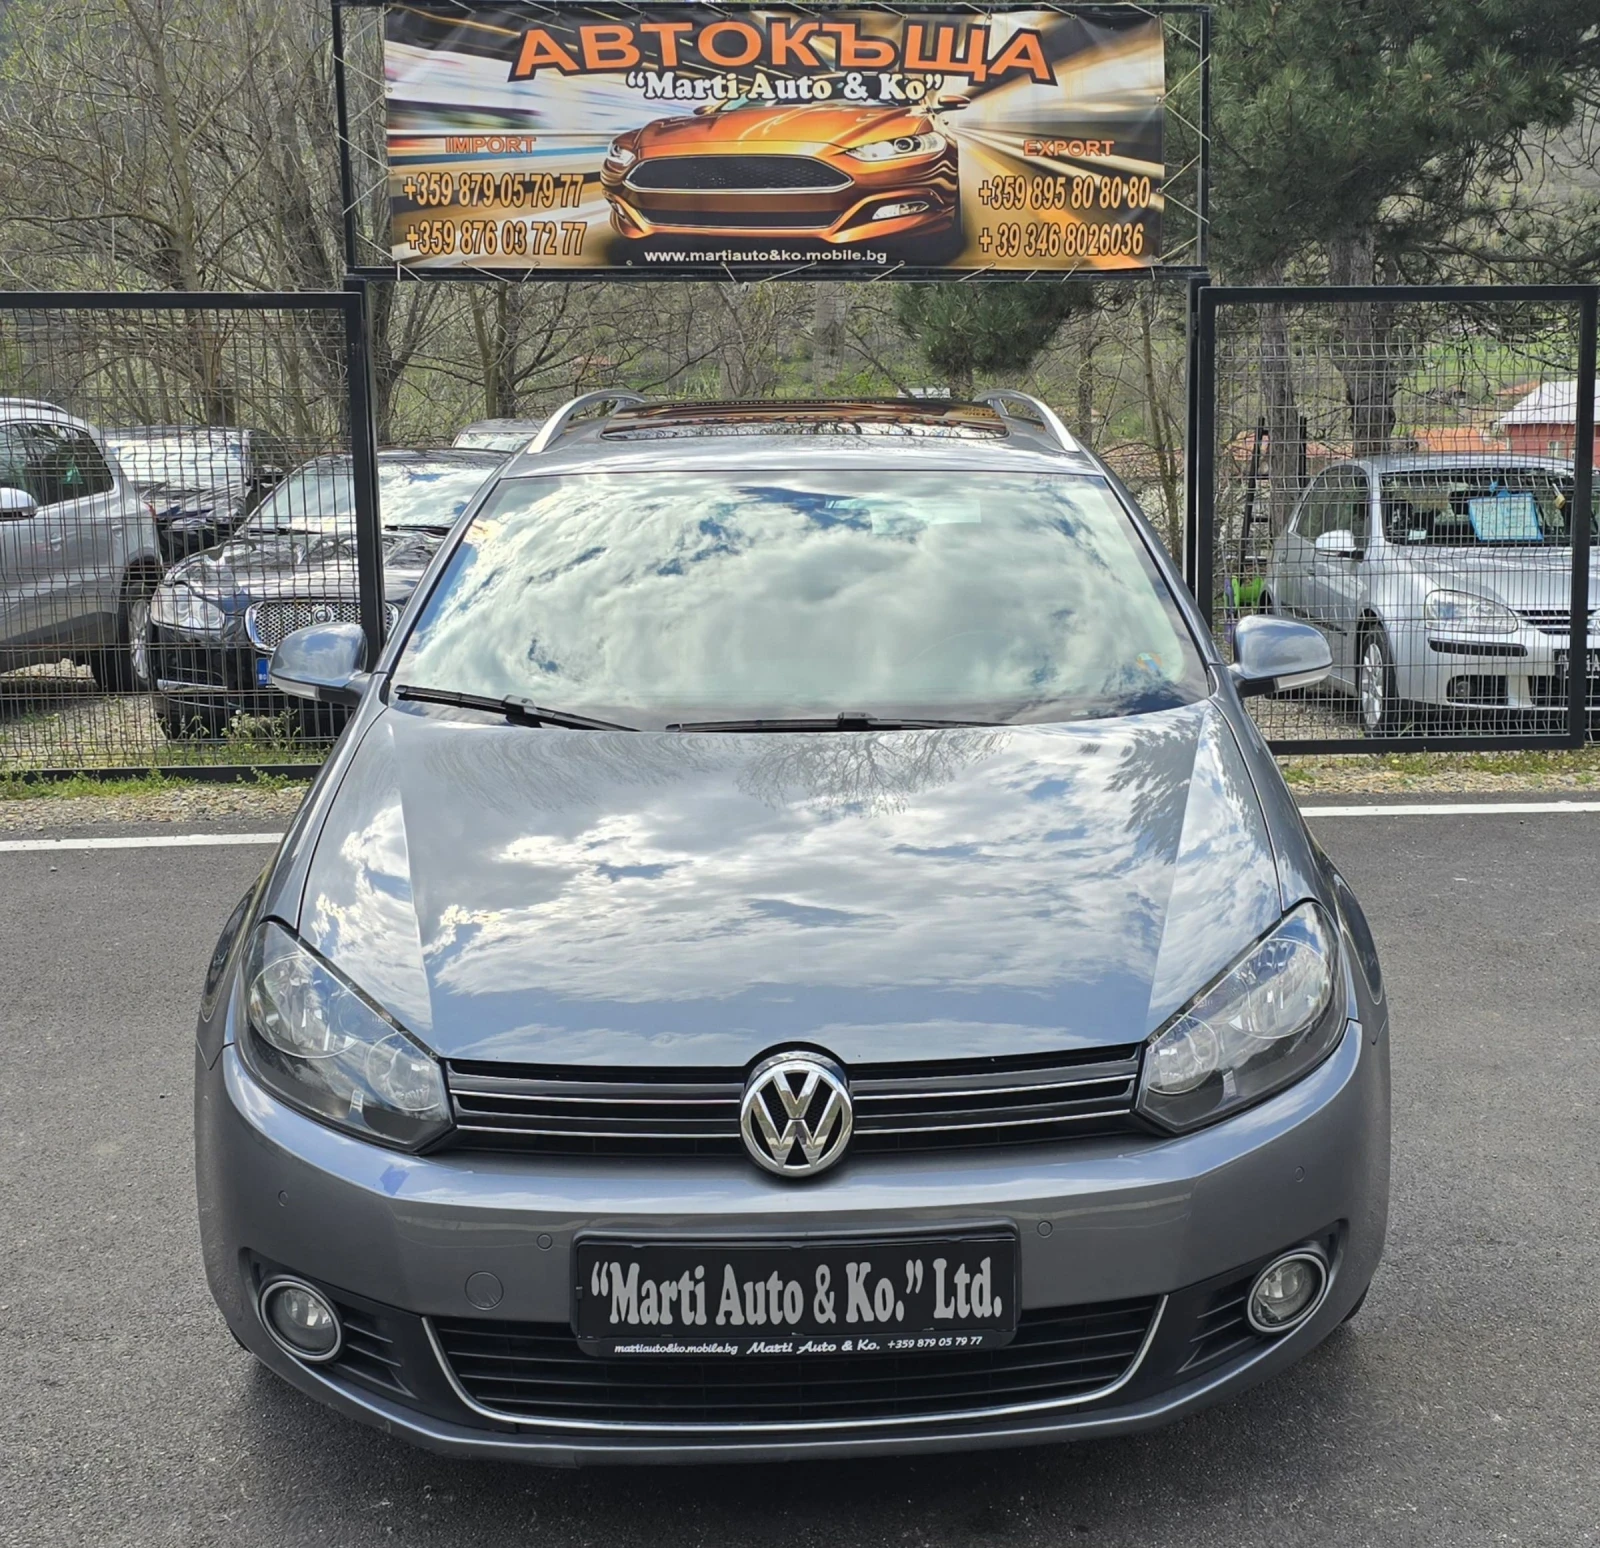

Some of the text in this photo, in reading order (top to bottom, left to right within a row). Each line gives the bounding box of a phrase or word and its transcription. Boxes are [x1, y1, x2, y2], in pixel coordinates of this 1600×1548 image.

[511, 20, 1055, 84] АВТОКЪЩА
[749, 72, 833, 100] Auto
[843, 72, 869, 101] &
[444, 136, 537, 154] IMPORT
[1022, 140, 1115, 156] EXPORT
[403, 172, 584, 208] +359 879 05 79 77
[978, 175, 1151, 210] +359 895 80 80 80
[405, 220, 587, 256] +359 876 03 72 77
[1024, 222, 1061, 257] 346
[1064, 222, 1144, 257] 8026036
[644, 249, 887, 264] www.martiauto&ko.mobile.bg
[715, 1263, 803, 1326] Auto
[813, 1264, 836, 1324] &
[933, 1256, 1003, 1320] Ltd.
[746, 1342, 792, 1354] Marti
[796, 1341, 836, 1354] Auto
[841, 1340, 853, 1351] &
[857, 1339, 880, 1351] Ko.
[887, 1339, 915, 1349] +359
[917, 1339, 935, 1347] 879
[938, 1338, 952, 1347] 05
[955, 1337, 968, 1346] 79
[970, 1336, 983, 1345] 77
